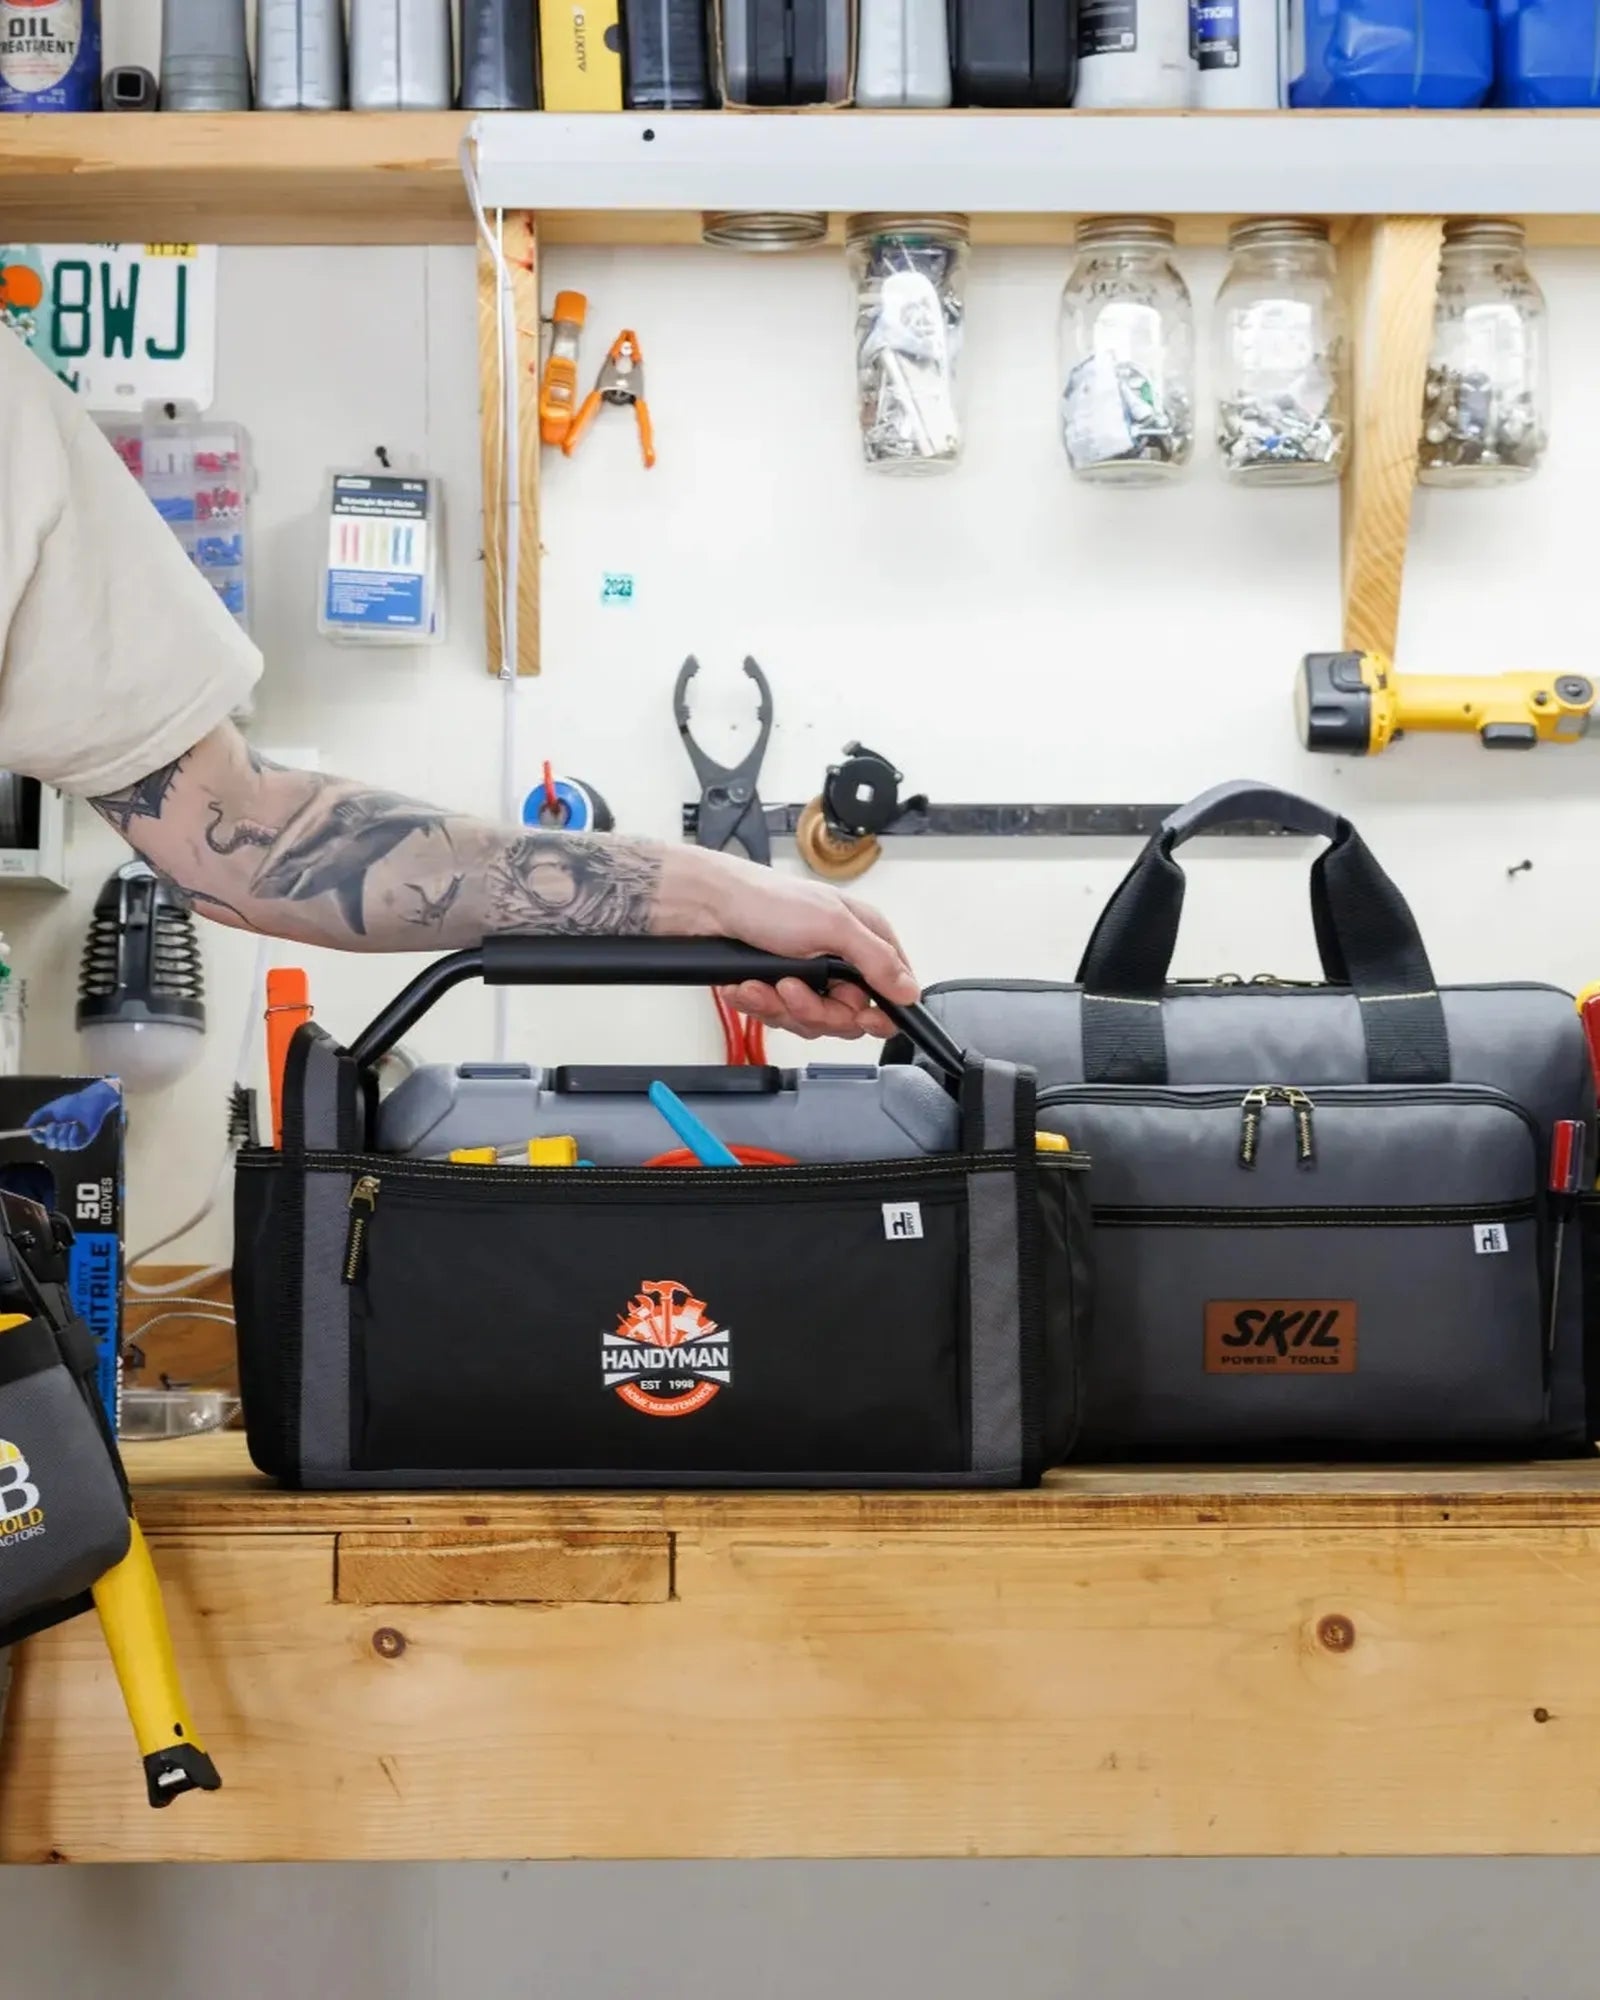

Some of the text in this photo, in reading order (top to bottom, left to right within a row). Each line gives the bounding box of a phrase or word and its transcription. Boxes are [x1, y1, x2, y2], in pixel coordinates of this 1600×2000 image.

[8, 17, 54, 37] OIL
[0, 39, 75, 54] REATMENT
[52, 261, 187, 360] 8WJ
[603, 578, 632, 597] 2023
[76, 1183, 100, 1219] 50
[100, 1177, 113, 1225] GLOVES
[1221, 1309, 1339, 1356] SKIL
[601, 1347, 729, 1370] HANDYMAN
[1221, 1356, 1339, 1365] POWER TOOLS
[640, 1380, 695, 1390] EST 1998
